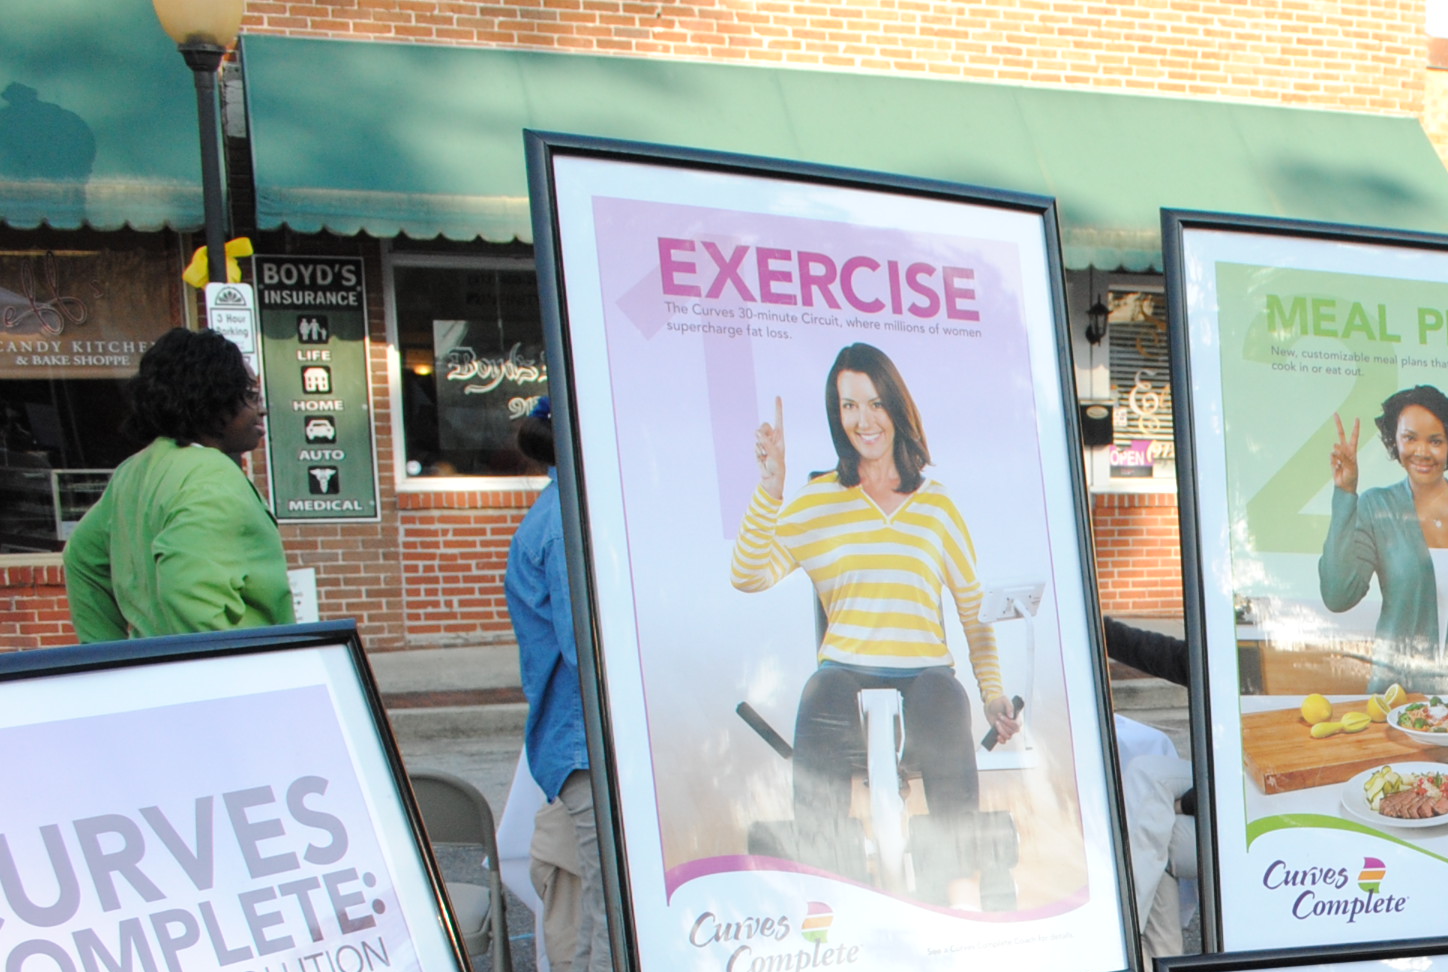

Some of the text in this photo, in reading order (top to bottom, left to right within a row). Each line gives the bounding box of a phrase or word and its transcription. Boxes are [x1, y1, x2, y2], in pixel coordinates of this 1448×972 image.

[263, 263, 357, 287] BOYD'S
[657, 237, 980, 322] EXERCISE
[264, 290, 358, 306] INSURANCE
[226, 313, 246, 324] Hour
[664, 301, 982, 338] The Curves 30-minute Circuit, where millions of women
[1266, 294, 1402, 343] MEAL
[666, 320, 793, 340] supercharge fat loss.
[72, 340, 155, 353] KITCHE
[297, 350, 332, 361] LIFE
[15, 355, 130, 366] & BAKE SHOPPE
[1271, 346, 1298, 359] New,
[1301, 349, 1371, 363] customizable
[1373, 354, 1398, 366] meal
[1401, 356, 1429, 369] plans
[1271, 360, 1365, 377] cook in or eat out.
[292, 400, 344, 412] HOME
[299, 450, 345, 461] AUTO
[1110, 450, 1145, 466] OPEN
[288, 499, 363, 511] MEDICAL
[0, 775, 349, 929] URVES
[1263, 859, 1349, 890] Curves
[1291, 888, 1407, 923] Complete
[688, 911, 791, 948] Curves
